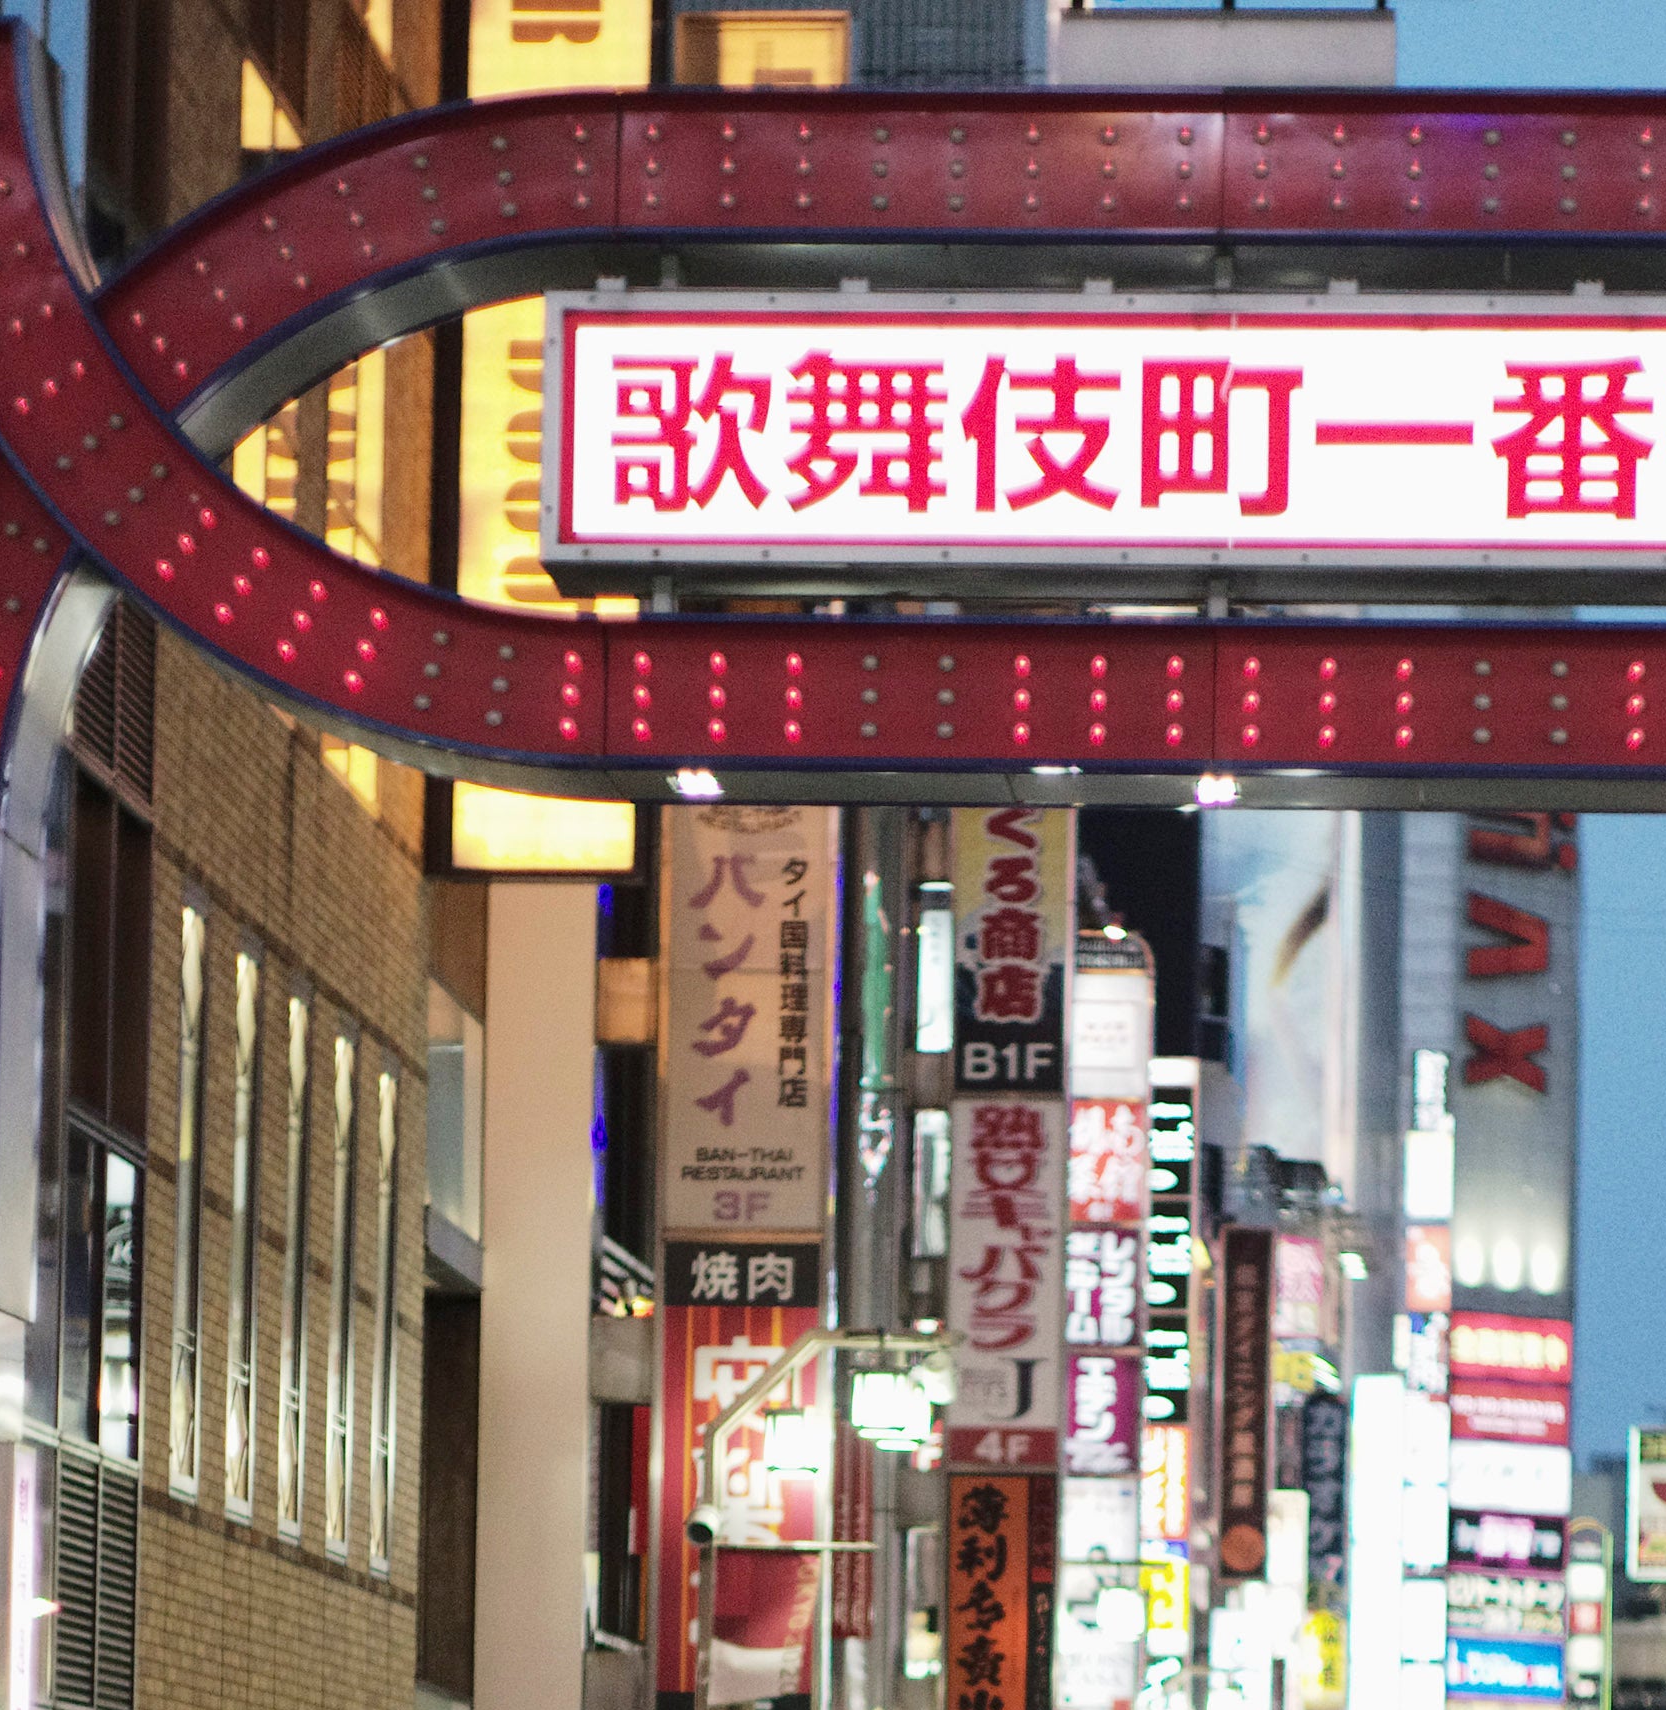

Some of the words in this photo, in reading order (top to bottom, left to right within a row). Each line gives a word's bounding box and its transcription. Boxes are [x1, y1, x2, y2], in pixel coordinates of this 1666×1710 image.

[777, 857, 809, 1108] タイ国料理専門店
[963, 1042, 1055, 1082] B1F
[696, 1146, 793, 1162] BAN-THAI
[681, 1165, 806, 1181] RESTAURANT
[713, 1190, 771, 1221] 3F
[691, 1250, 796, 1301] 焼肉
[974, 1431, 1032, 1464] 4F
